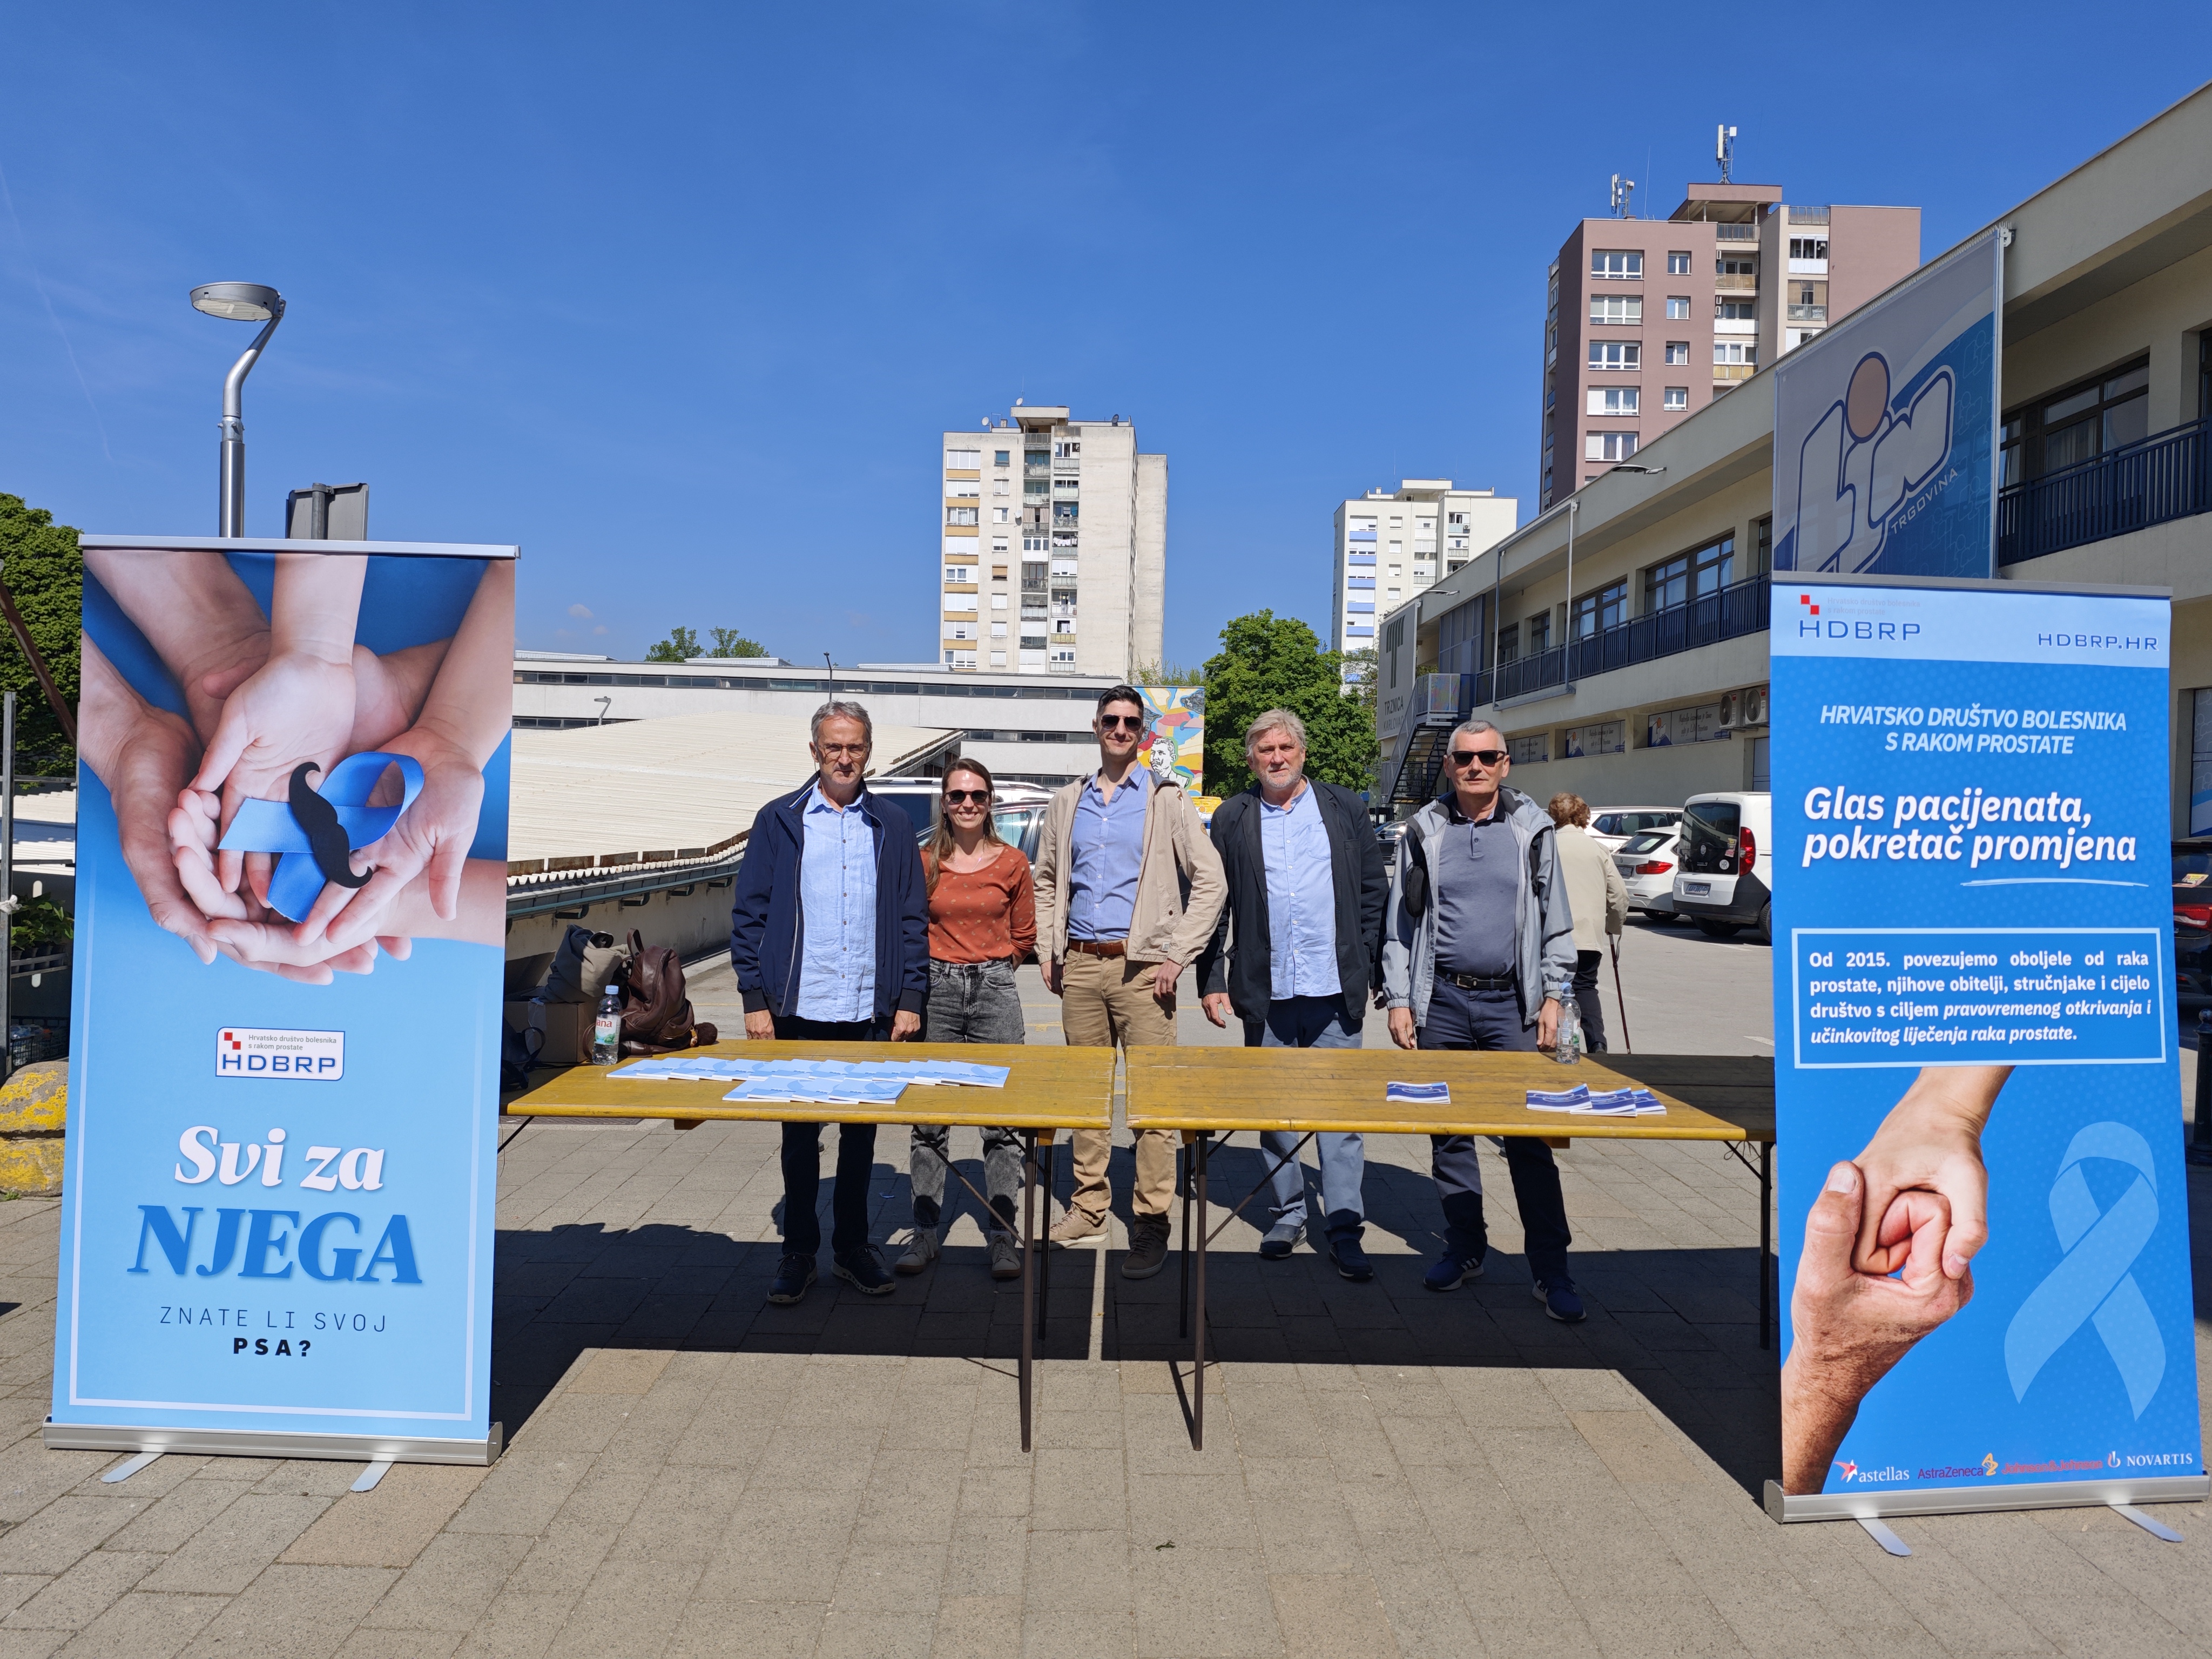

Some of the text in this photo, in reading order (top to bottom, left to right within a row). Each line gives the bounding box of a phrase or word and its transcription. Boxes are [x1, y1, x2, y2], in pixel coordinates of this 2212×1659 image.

[1891, 468, 1958, 534] TRGOVINA
[1800, 621, 1920, 640] HDBRP
[2039, 633, 2157, 650] HDBRP.HR
[1820, 703, 2126, 731] HRVATSKO DRUŠTVO BOLESNIKA
[1885, 732, 2075, 754] S RAKOM PROSTATE
[1804, 786, 2091, 830] Glas pacijenata,
[1802, 825, 2135, 868] pokretač promjena
[1810, 950, 2148, 970] Od 2015. povezujemo oboljele od raka
[1810, 975, 2150, 996] prostate, njihove obitelji, stručnjake i cijelo
[1810, 1000, 2151, 1020] društvo s ciljem pravovremenog otkrivanja i
[1811, 1026, 2077, 1046] učinkovitog liječenja raka prostate.
[222, 1054, 335, 1073] HDBRP
[175, 1126, 385, 1191] Svi za
[127, 1205, 422, 1285] NJEGA
[160, 1307, 385, 1332] ZNATE LI SVOJ
[234, 1338, 311, 1357] PSA?
[2127, 1453, 2193, 1466] NOVARTIS
[1859, 1467, 1909, 1482] astellas
[1917, 1465, 1984, 1479] AstraZeneca
